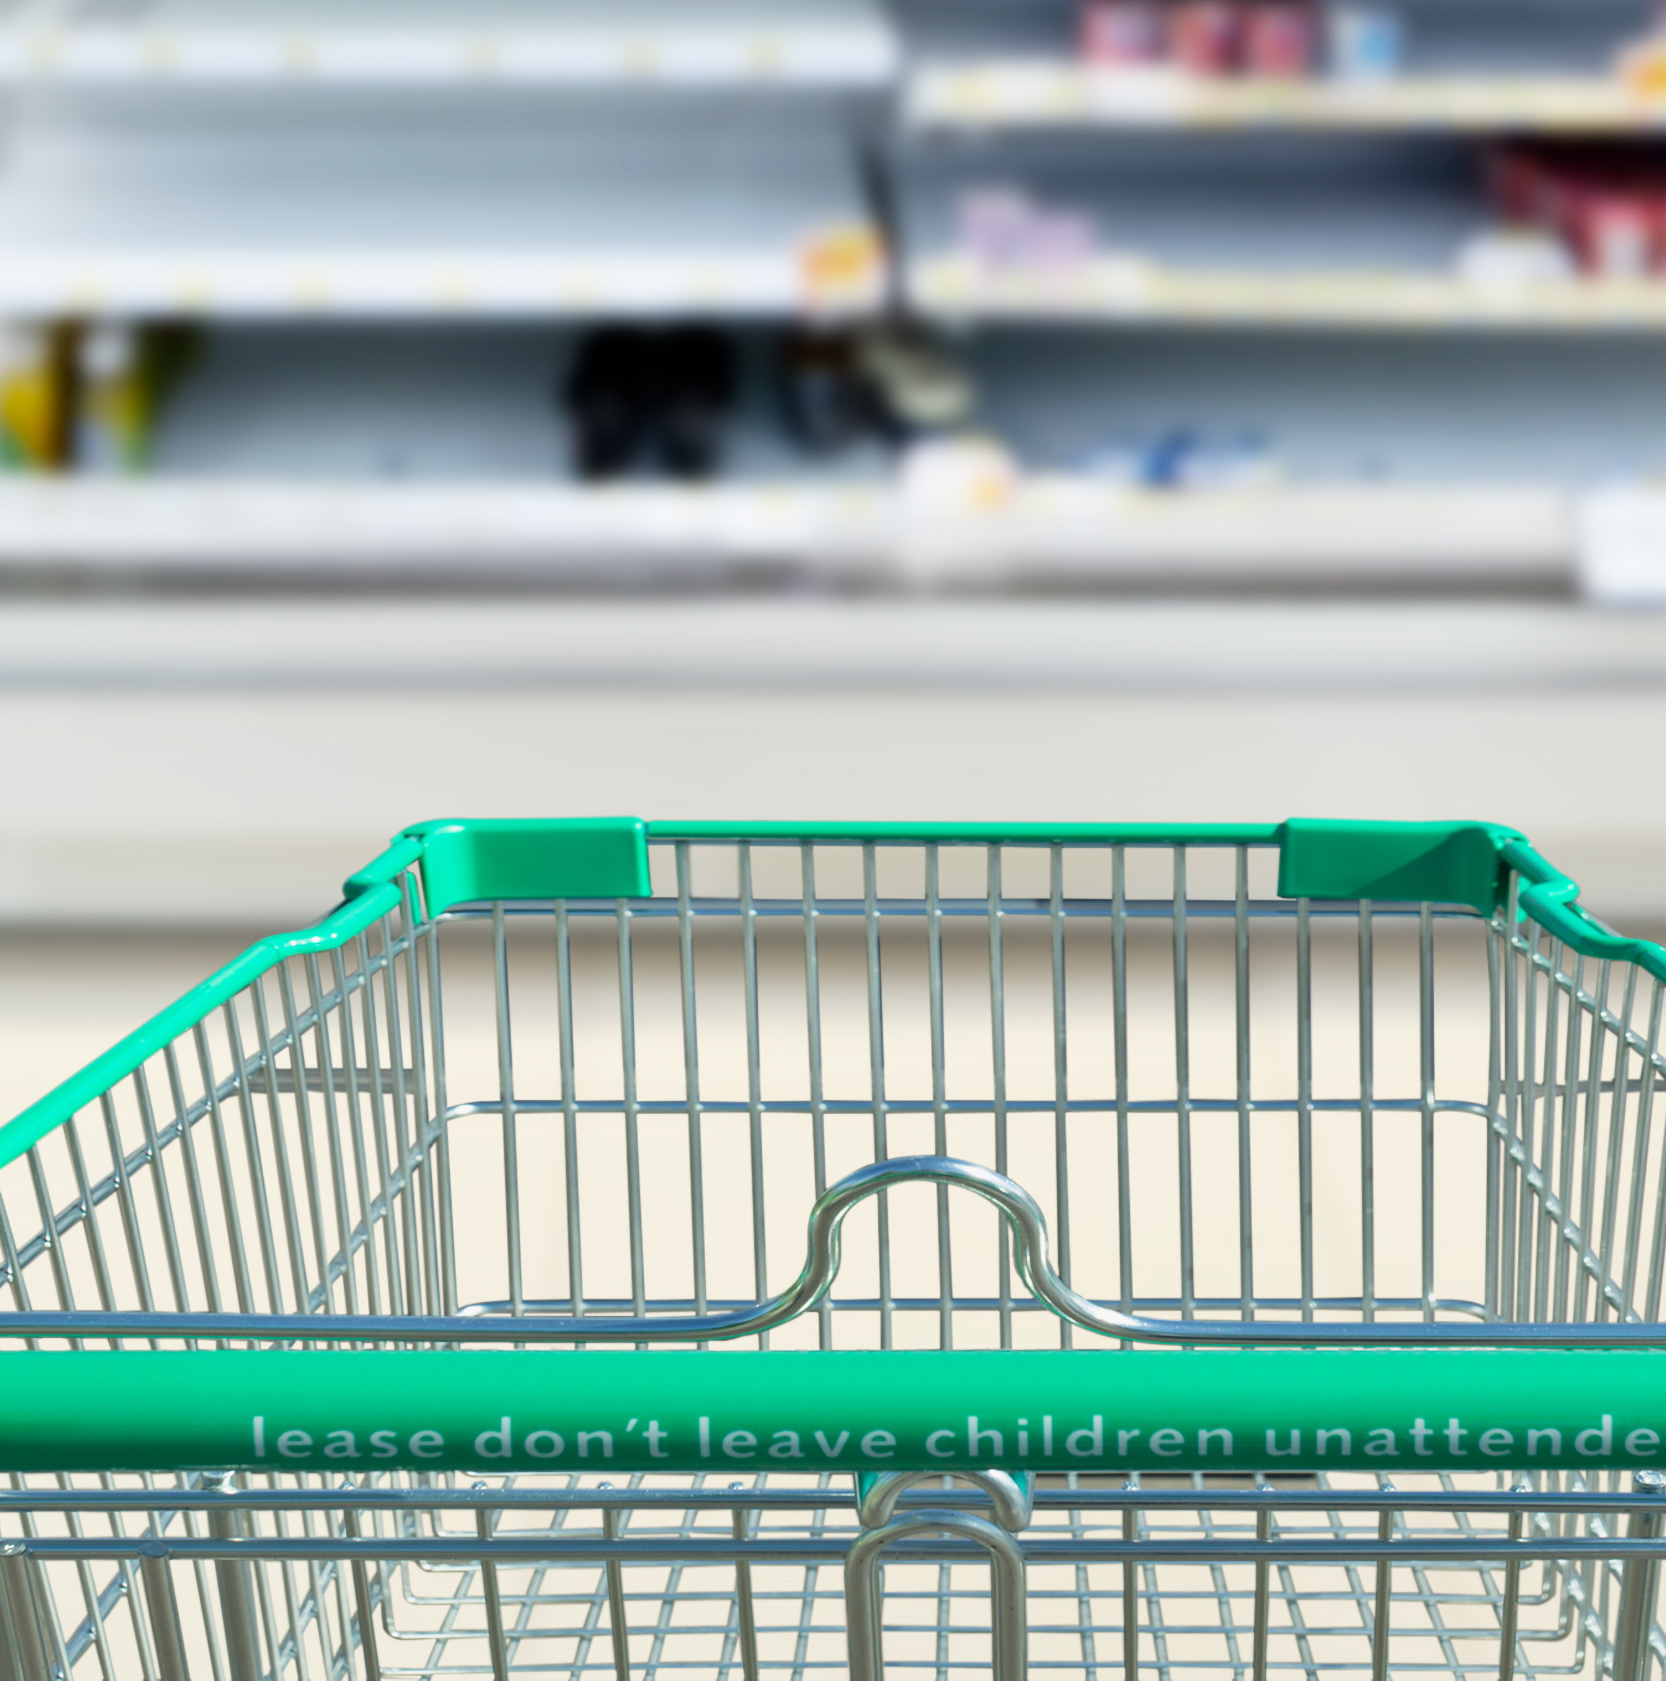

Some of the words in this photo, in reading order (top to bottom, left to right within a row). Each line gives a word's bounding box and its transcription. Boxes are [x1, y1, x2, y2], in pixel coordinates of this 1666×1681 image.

[251, 1414, 444, 1458] lease
[473, 1414, 667, 1458] don't
[697, 1414, 897, 1458] leave
[924, 1413, 1233, 1458] children
